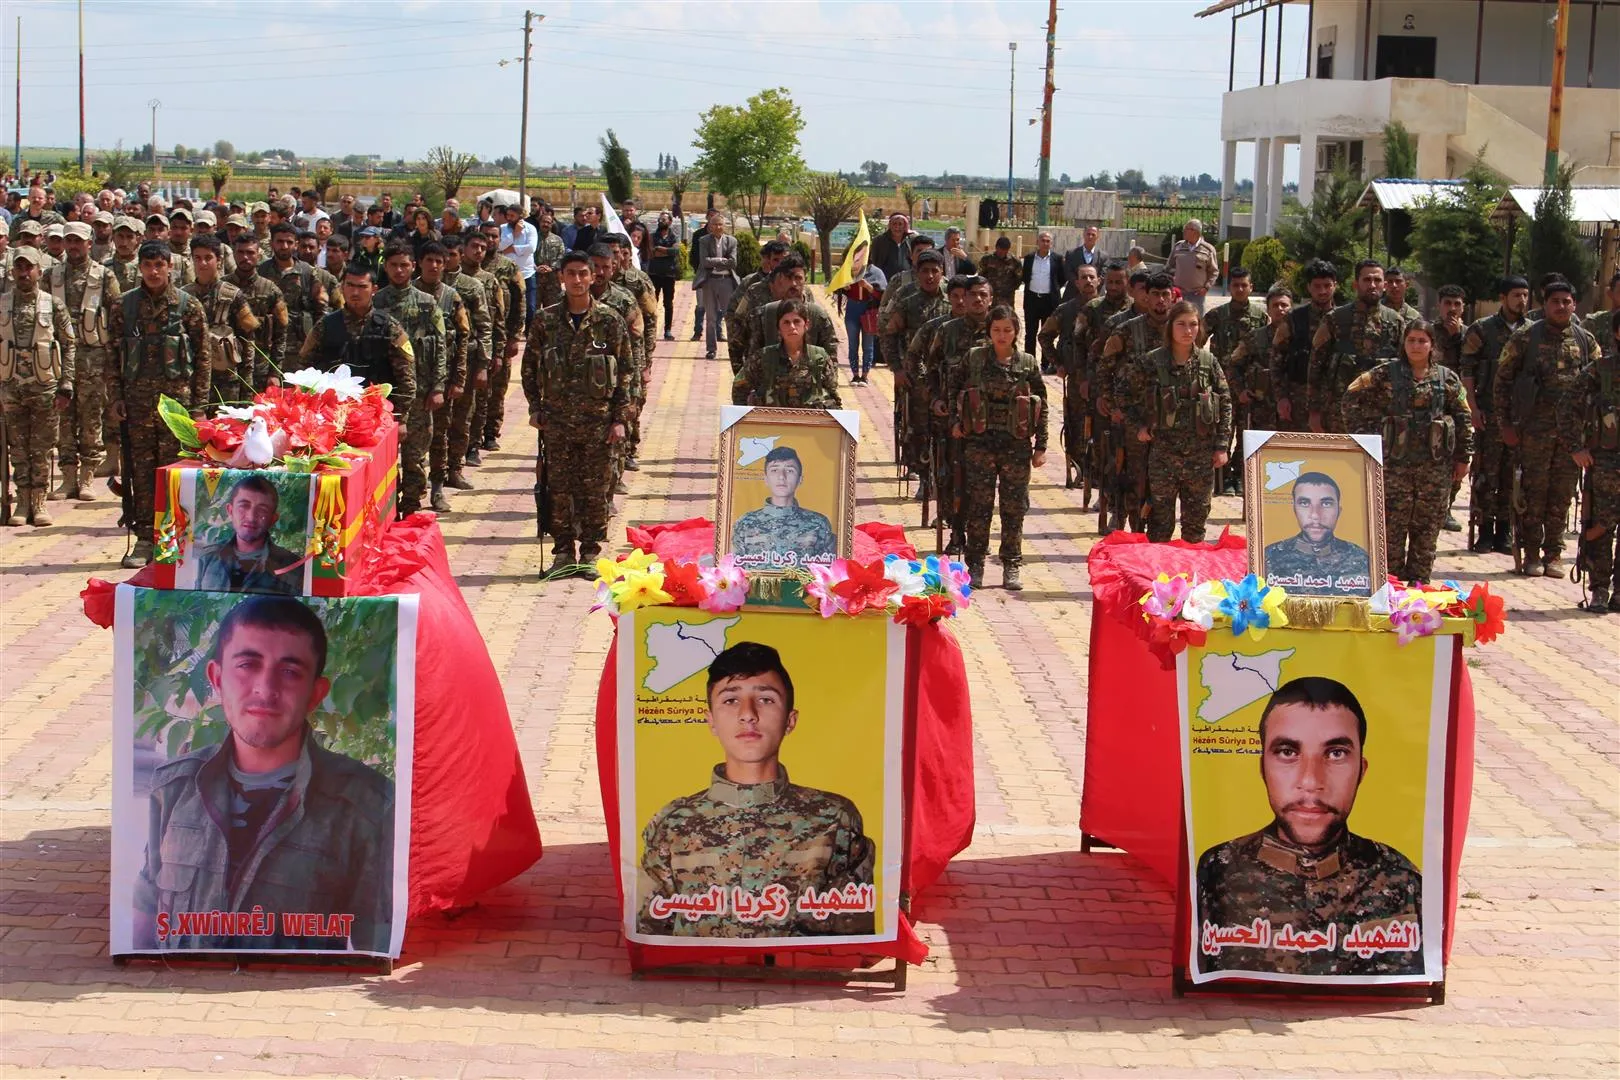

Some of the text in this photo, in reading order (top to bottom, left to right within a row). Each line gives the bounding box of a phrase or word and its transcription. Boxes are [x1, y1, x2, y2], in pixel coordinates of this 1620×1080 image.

[1304, 575, 1332, 588] احمد
[650, 883, 875, 920] الشهيد زكريا العيسى
[157, 905, 354, 941] Ş.XWÎNRÊJ WELAT
[1202, 917, 1419, 958] الشهيد احمد الحسين
